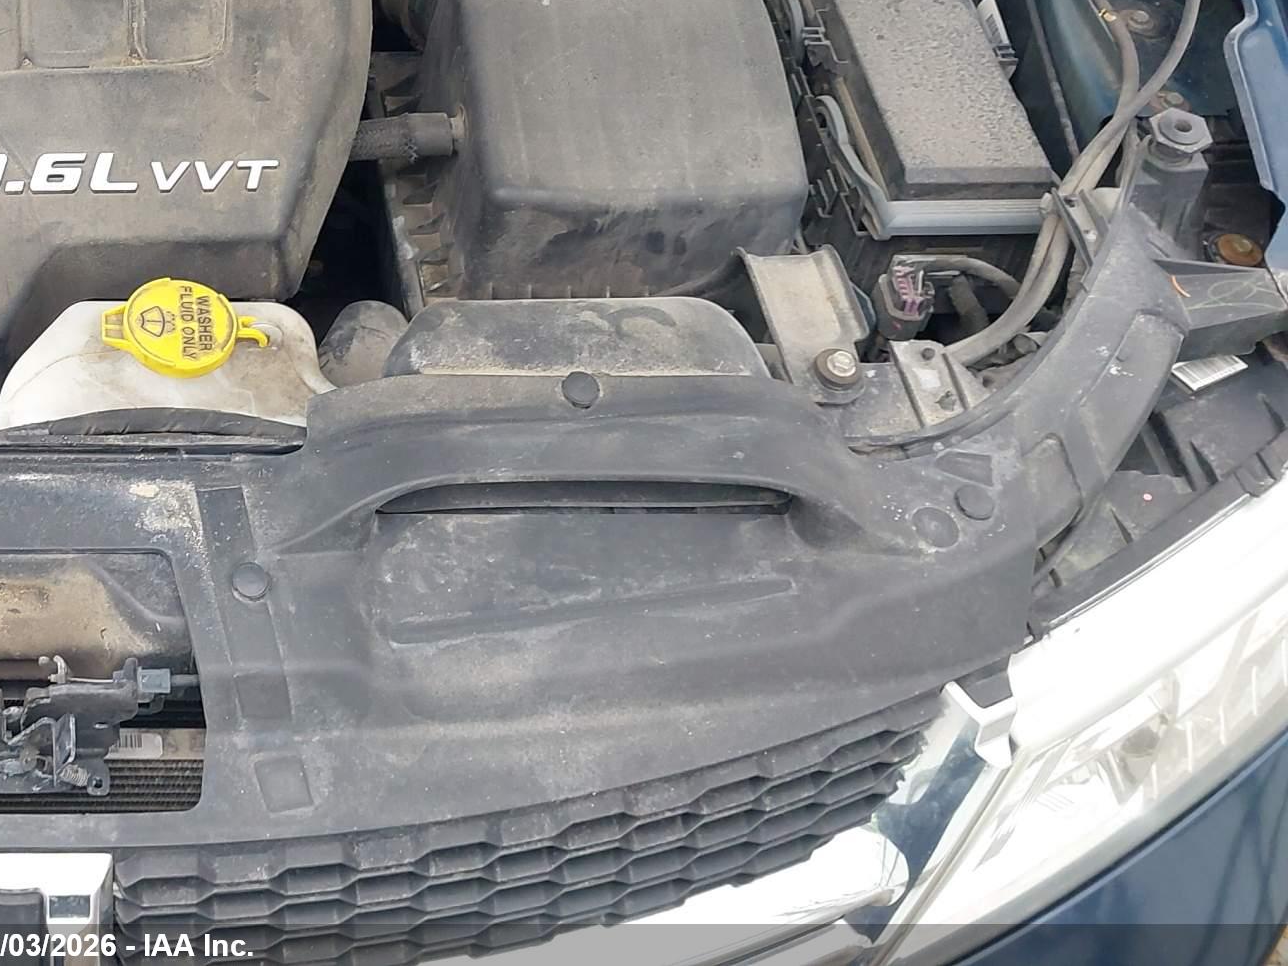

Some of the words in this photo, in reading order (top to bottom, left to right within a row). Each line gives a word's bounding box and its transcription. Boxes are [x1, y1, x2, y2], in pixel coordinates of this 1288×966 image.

[150, 159, 279, 193] VVT
[180, 286, 194, 322] FLUID
[196, 295, 212, 351] WASHER
[182, 327, 197, 360] ONLY
